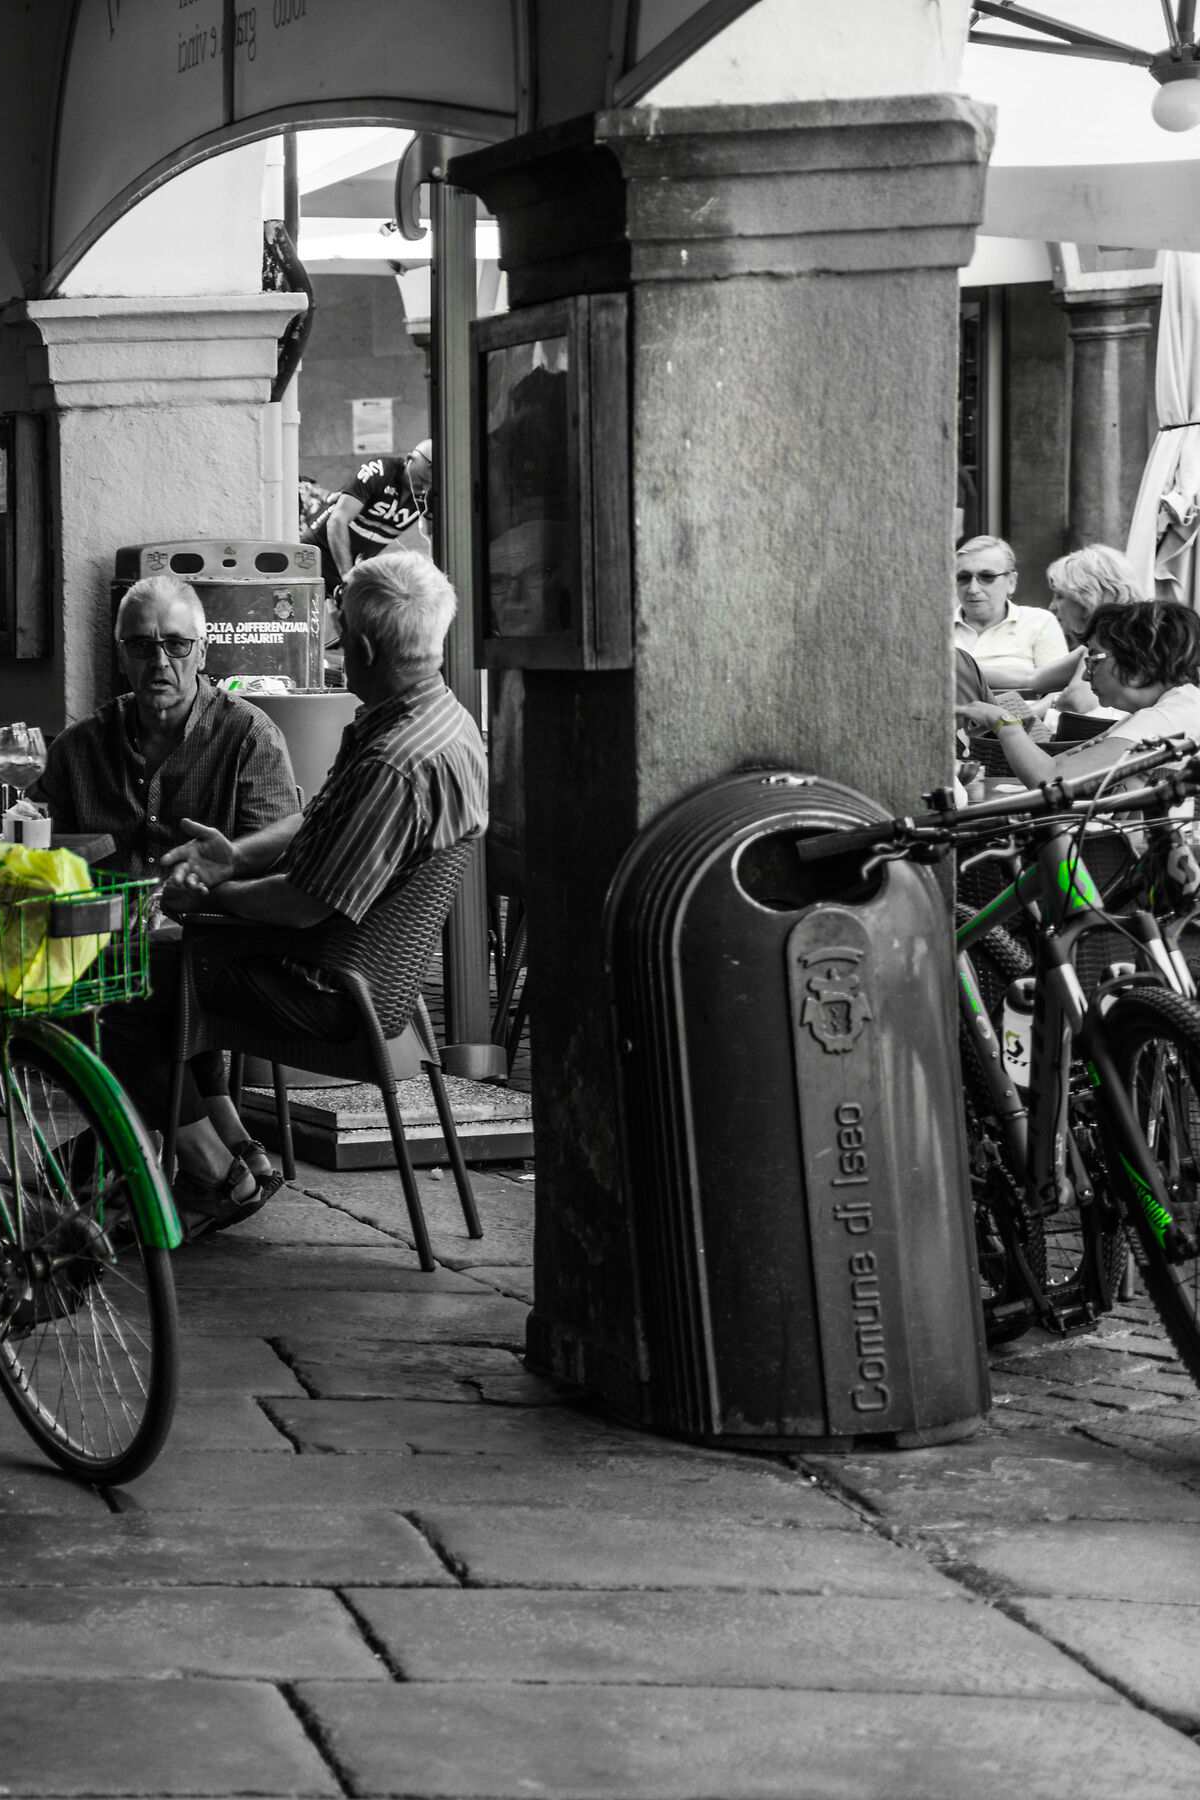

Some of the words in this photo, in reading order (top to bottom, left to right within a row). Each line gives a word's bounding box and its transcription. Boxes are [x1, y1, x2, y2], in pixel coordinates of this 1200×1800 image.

[357, 458, 385, 484] sky
[368, 498, 421, 528] sky
[208, 633, 234, 645] PILE
[234, 633, 285, 645] ESAURITE
[235, 621, 309, 634] DIFFERENZIATA
[832, 1101, 870, 1188] Iseo
[834, 1199, 872, 1237] di
[850, 1250, 888, 1413] Comune
